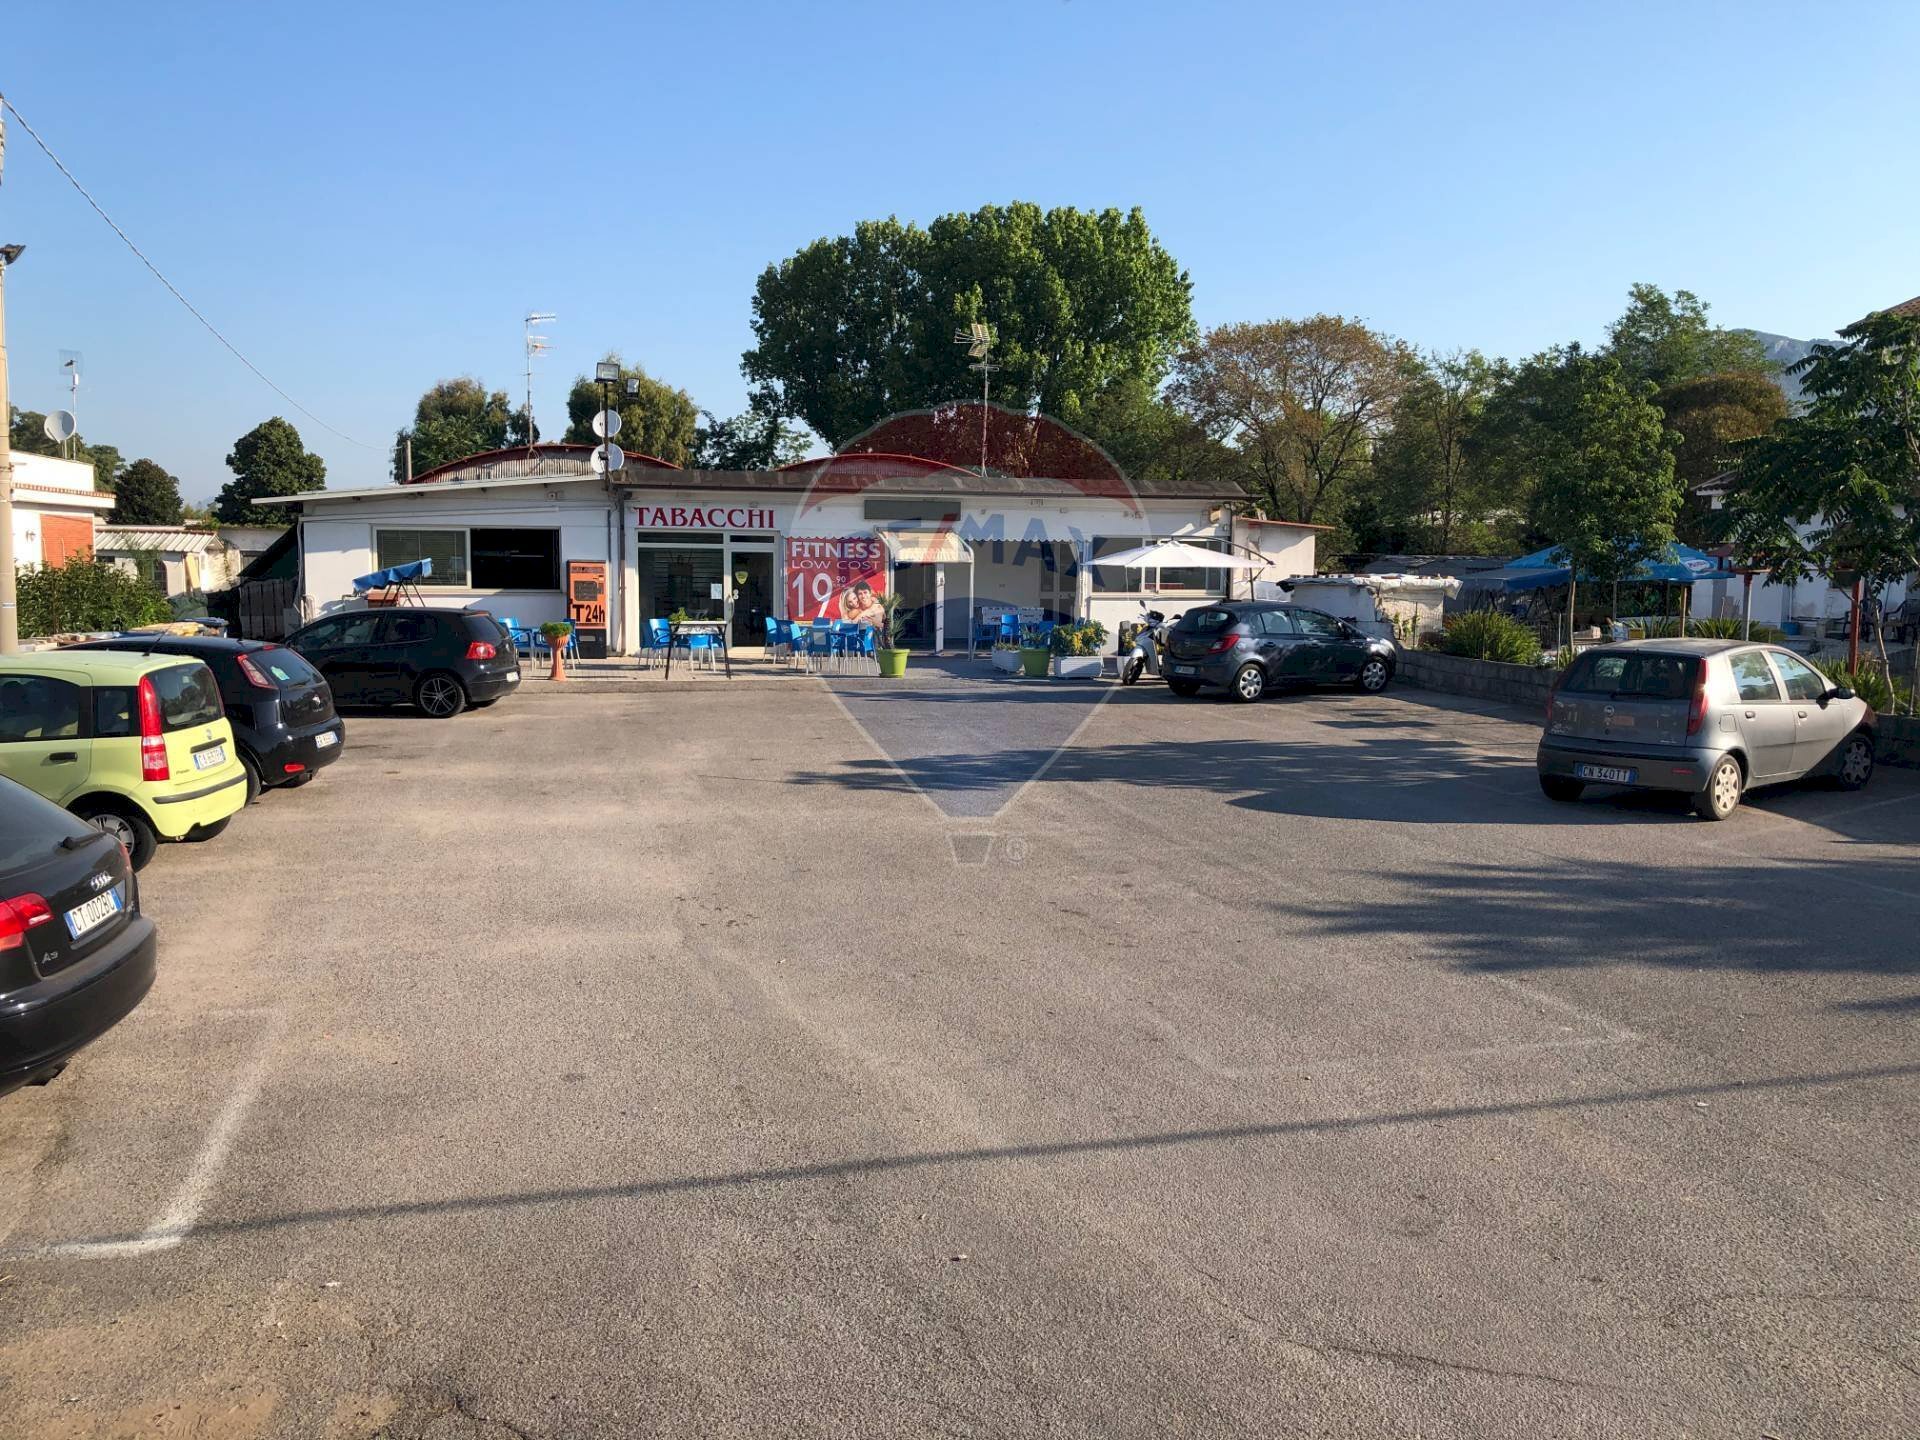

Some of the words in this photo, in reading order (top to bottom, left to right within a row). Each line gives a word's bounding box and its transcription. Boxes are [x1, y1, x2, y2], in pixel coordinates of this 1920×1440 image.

[633, 507, 774, 528] TABACCHI
[791, 541, 881, 559] FITNESS
[791, 560, 831, 569] LOW
[836, 560, 880, 570] COST
[792, 572, 833, 617] 19
